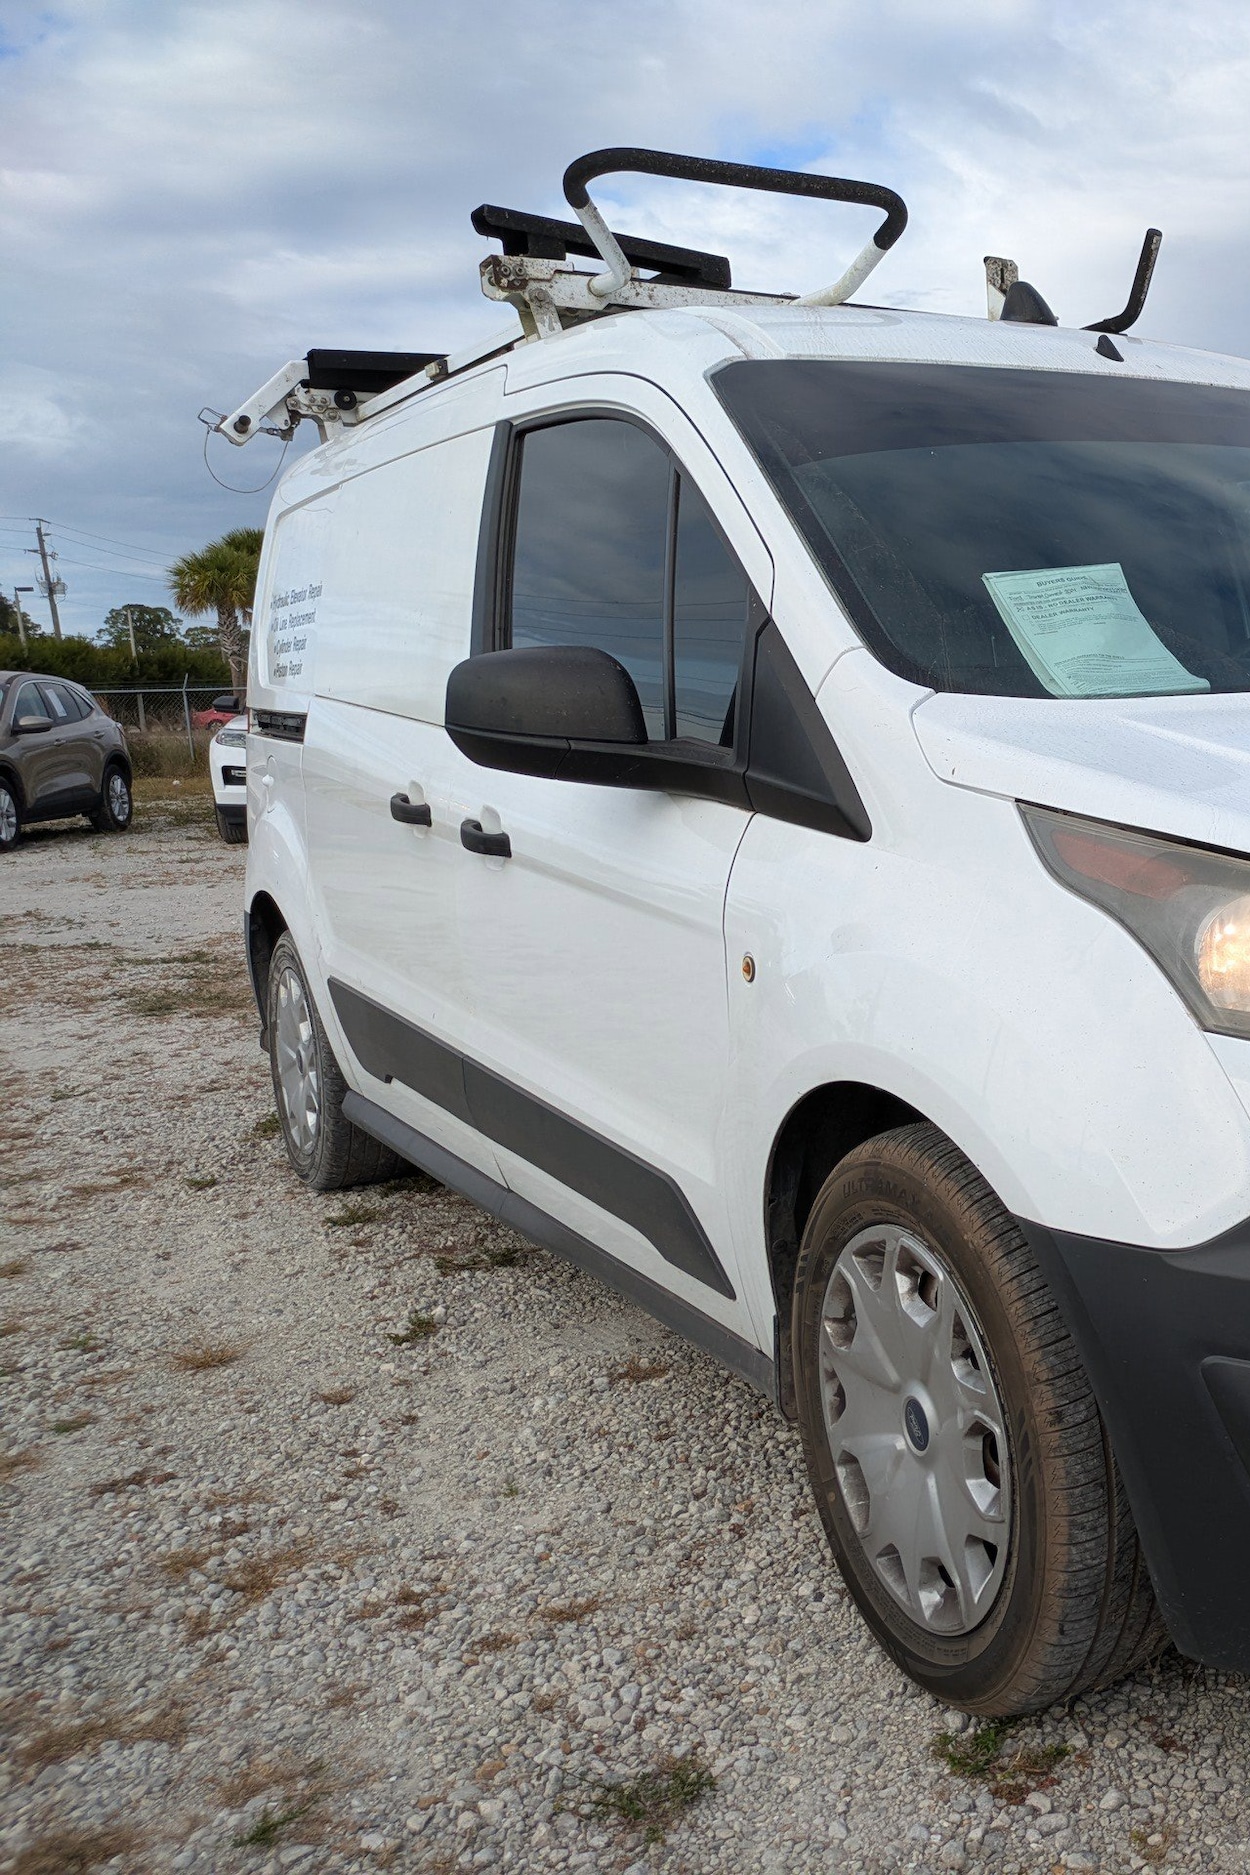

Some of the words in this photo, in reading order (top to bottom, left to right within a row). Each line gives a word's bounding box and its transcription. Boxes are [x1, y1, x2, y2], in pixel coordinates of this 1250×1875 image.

[1036, 577, 1066, 587] BUYERS
[308, 581, 322, 601] Repair
[1058, 597, 1085, 606] DEALER
[1031, 612, 1058, 620] DEALER
[1059, 606, 1094, 615] WARRANTY
[293, 634, 307, 653] Repair
[288, 659, 303, 679] Repair
